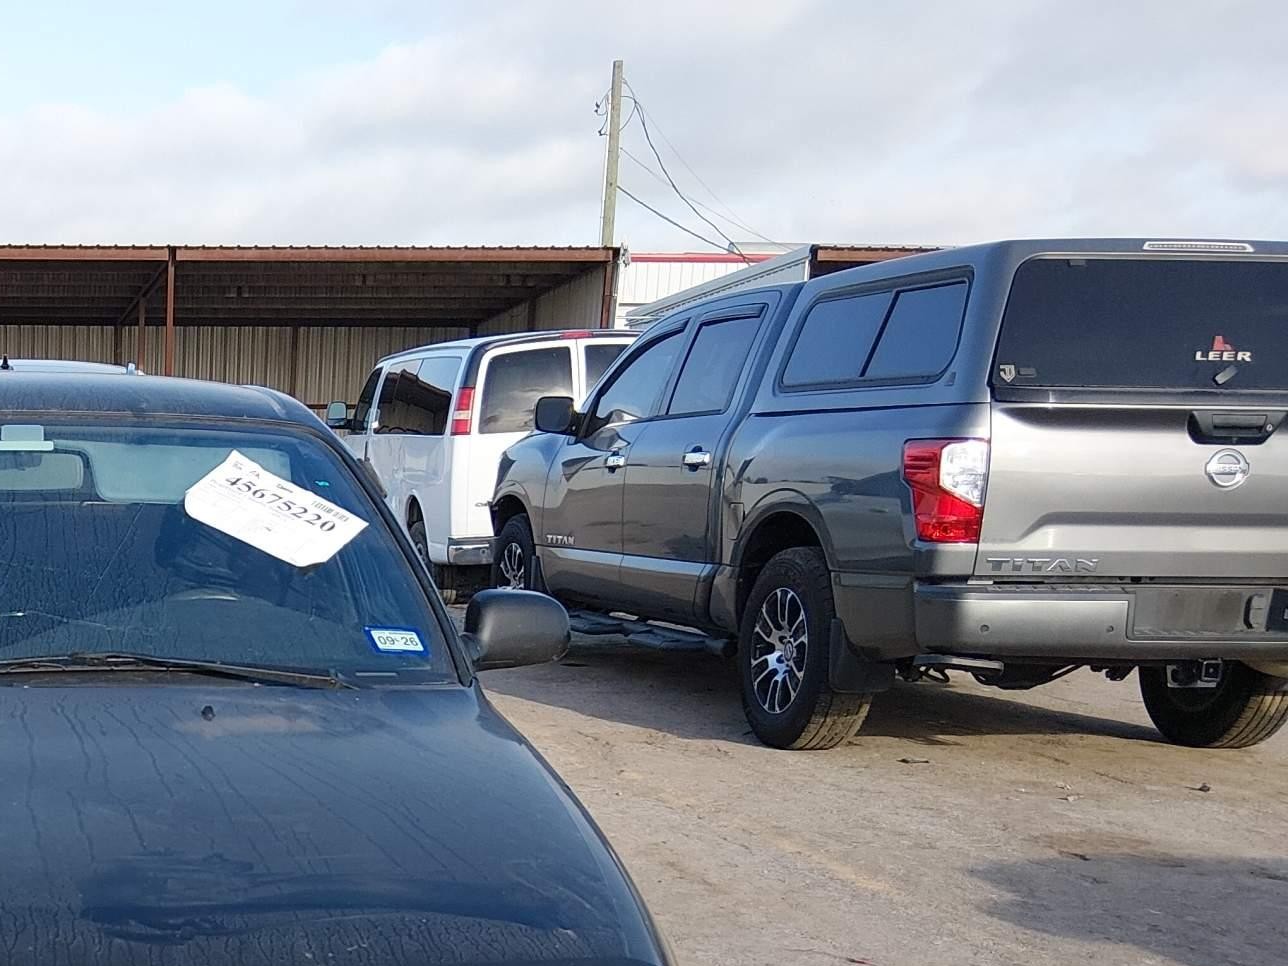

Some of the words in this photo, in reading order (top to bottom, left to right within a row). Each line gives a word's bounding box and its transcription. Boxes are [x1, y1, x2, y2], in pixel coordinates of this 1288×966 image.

[1195, 351, 1252, 362] LEER
[226, 475, 336, 532] 45675220
[546, 535, 575, 545] TITAN
[986, 557, 1099, 573] TITAN
